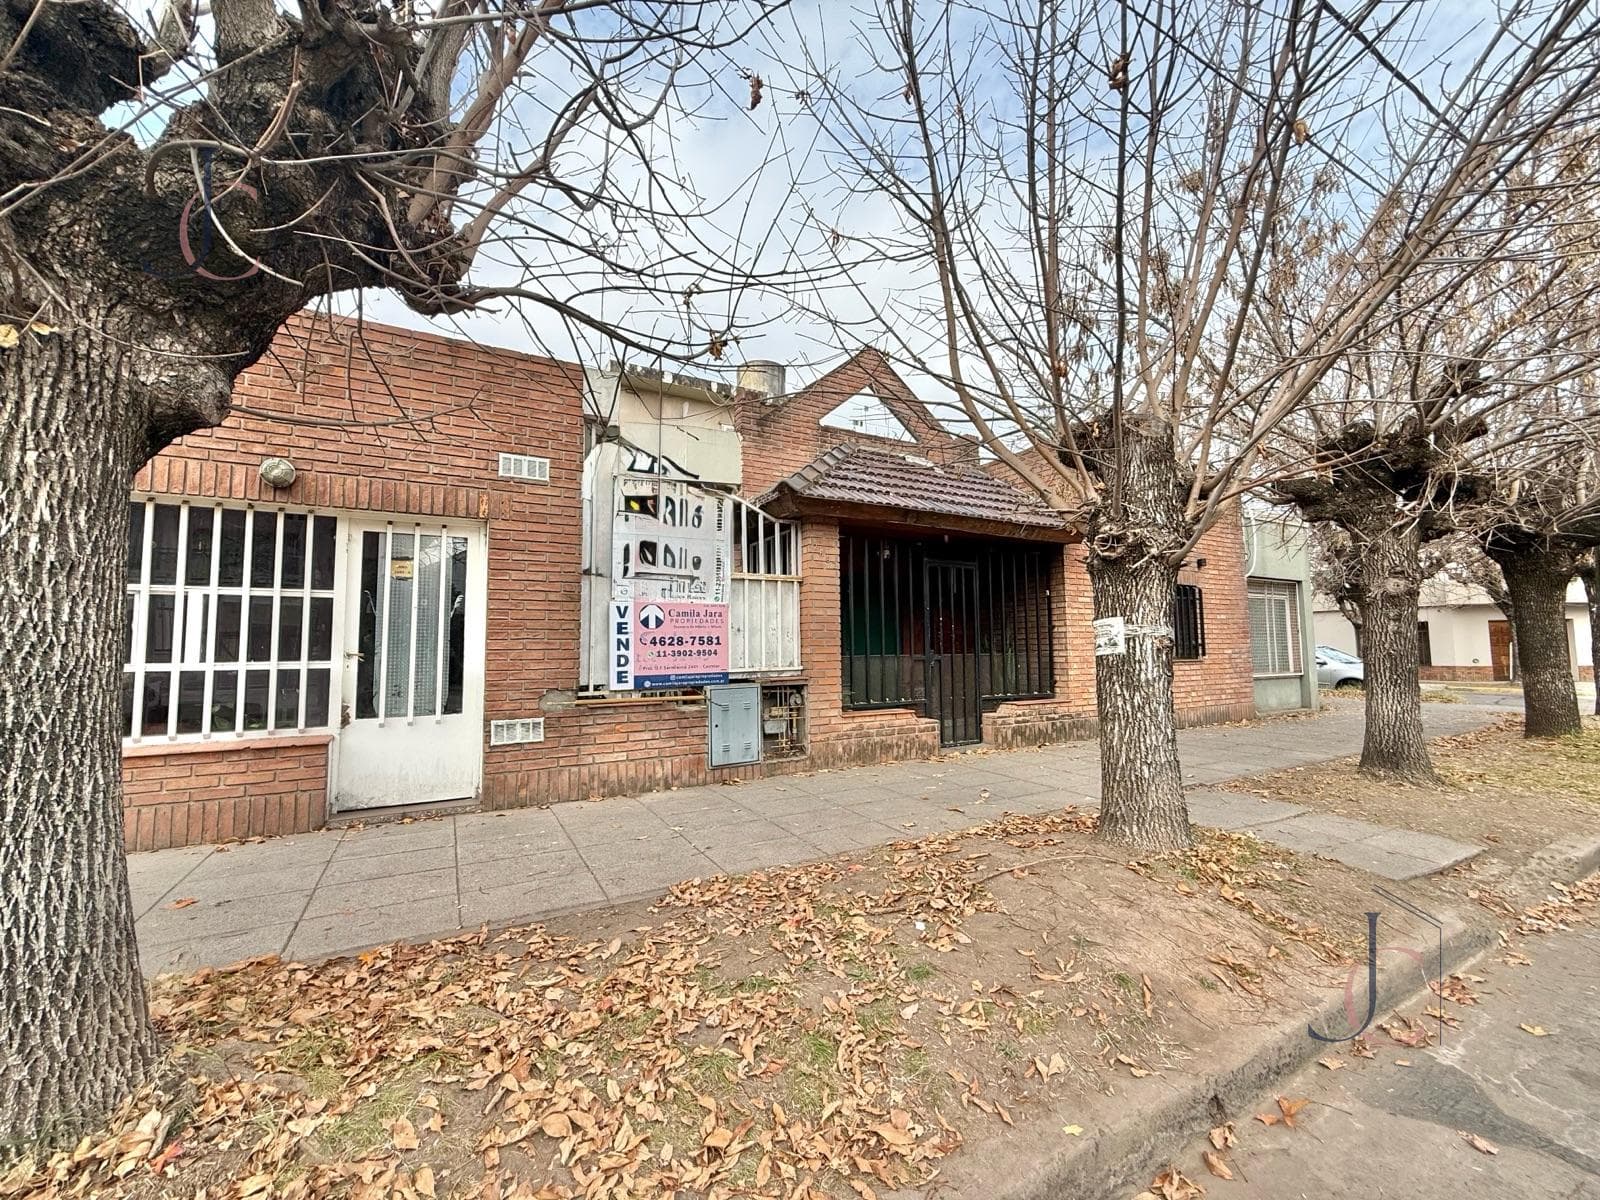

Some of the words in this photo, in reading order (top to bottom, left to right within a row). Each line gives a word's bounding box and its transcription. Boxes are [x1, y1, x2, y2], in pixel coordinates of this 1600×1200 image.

[668, 608, 701, 618] Camila
[703, 609, 723, 618] Jara
[616, 605, 630, 684] VENDE
[649, 635, 722, 647] 4628-7581
[656, 649, 718, 658] 11-3902-9504
